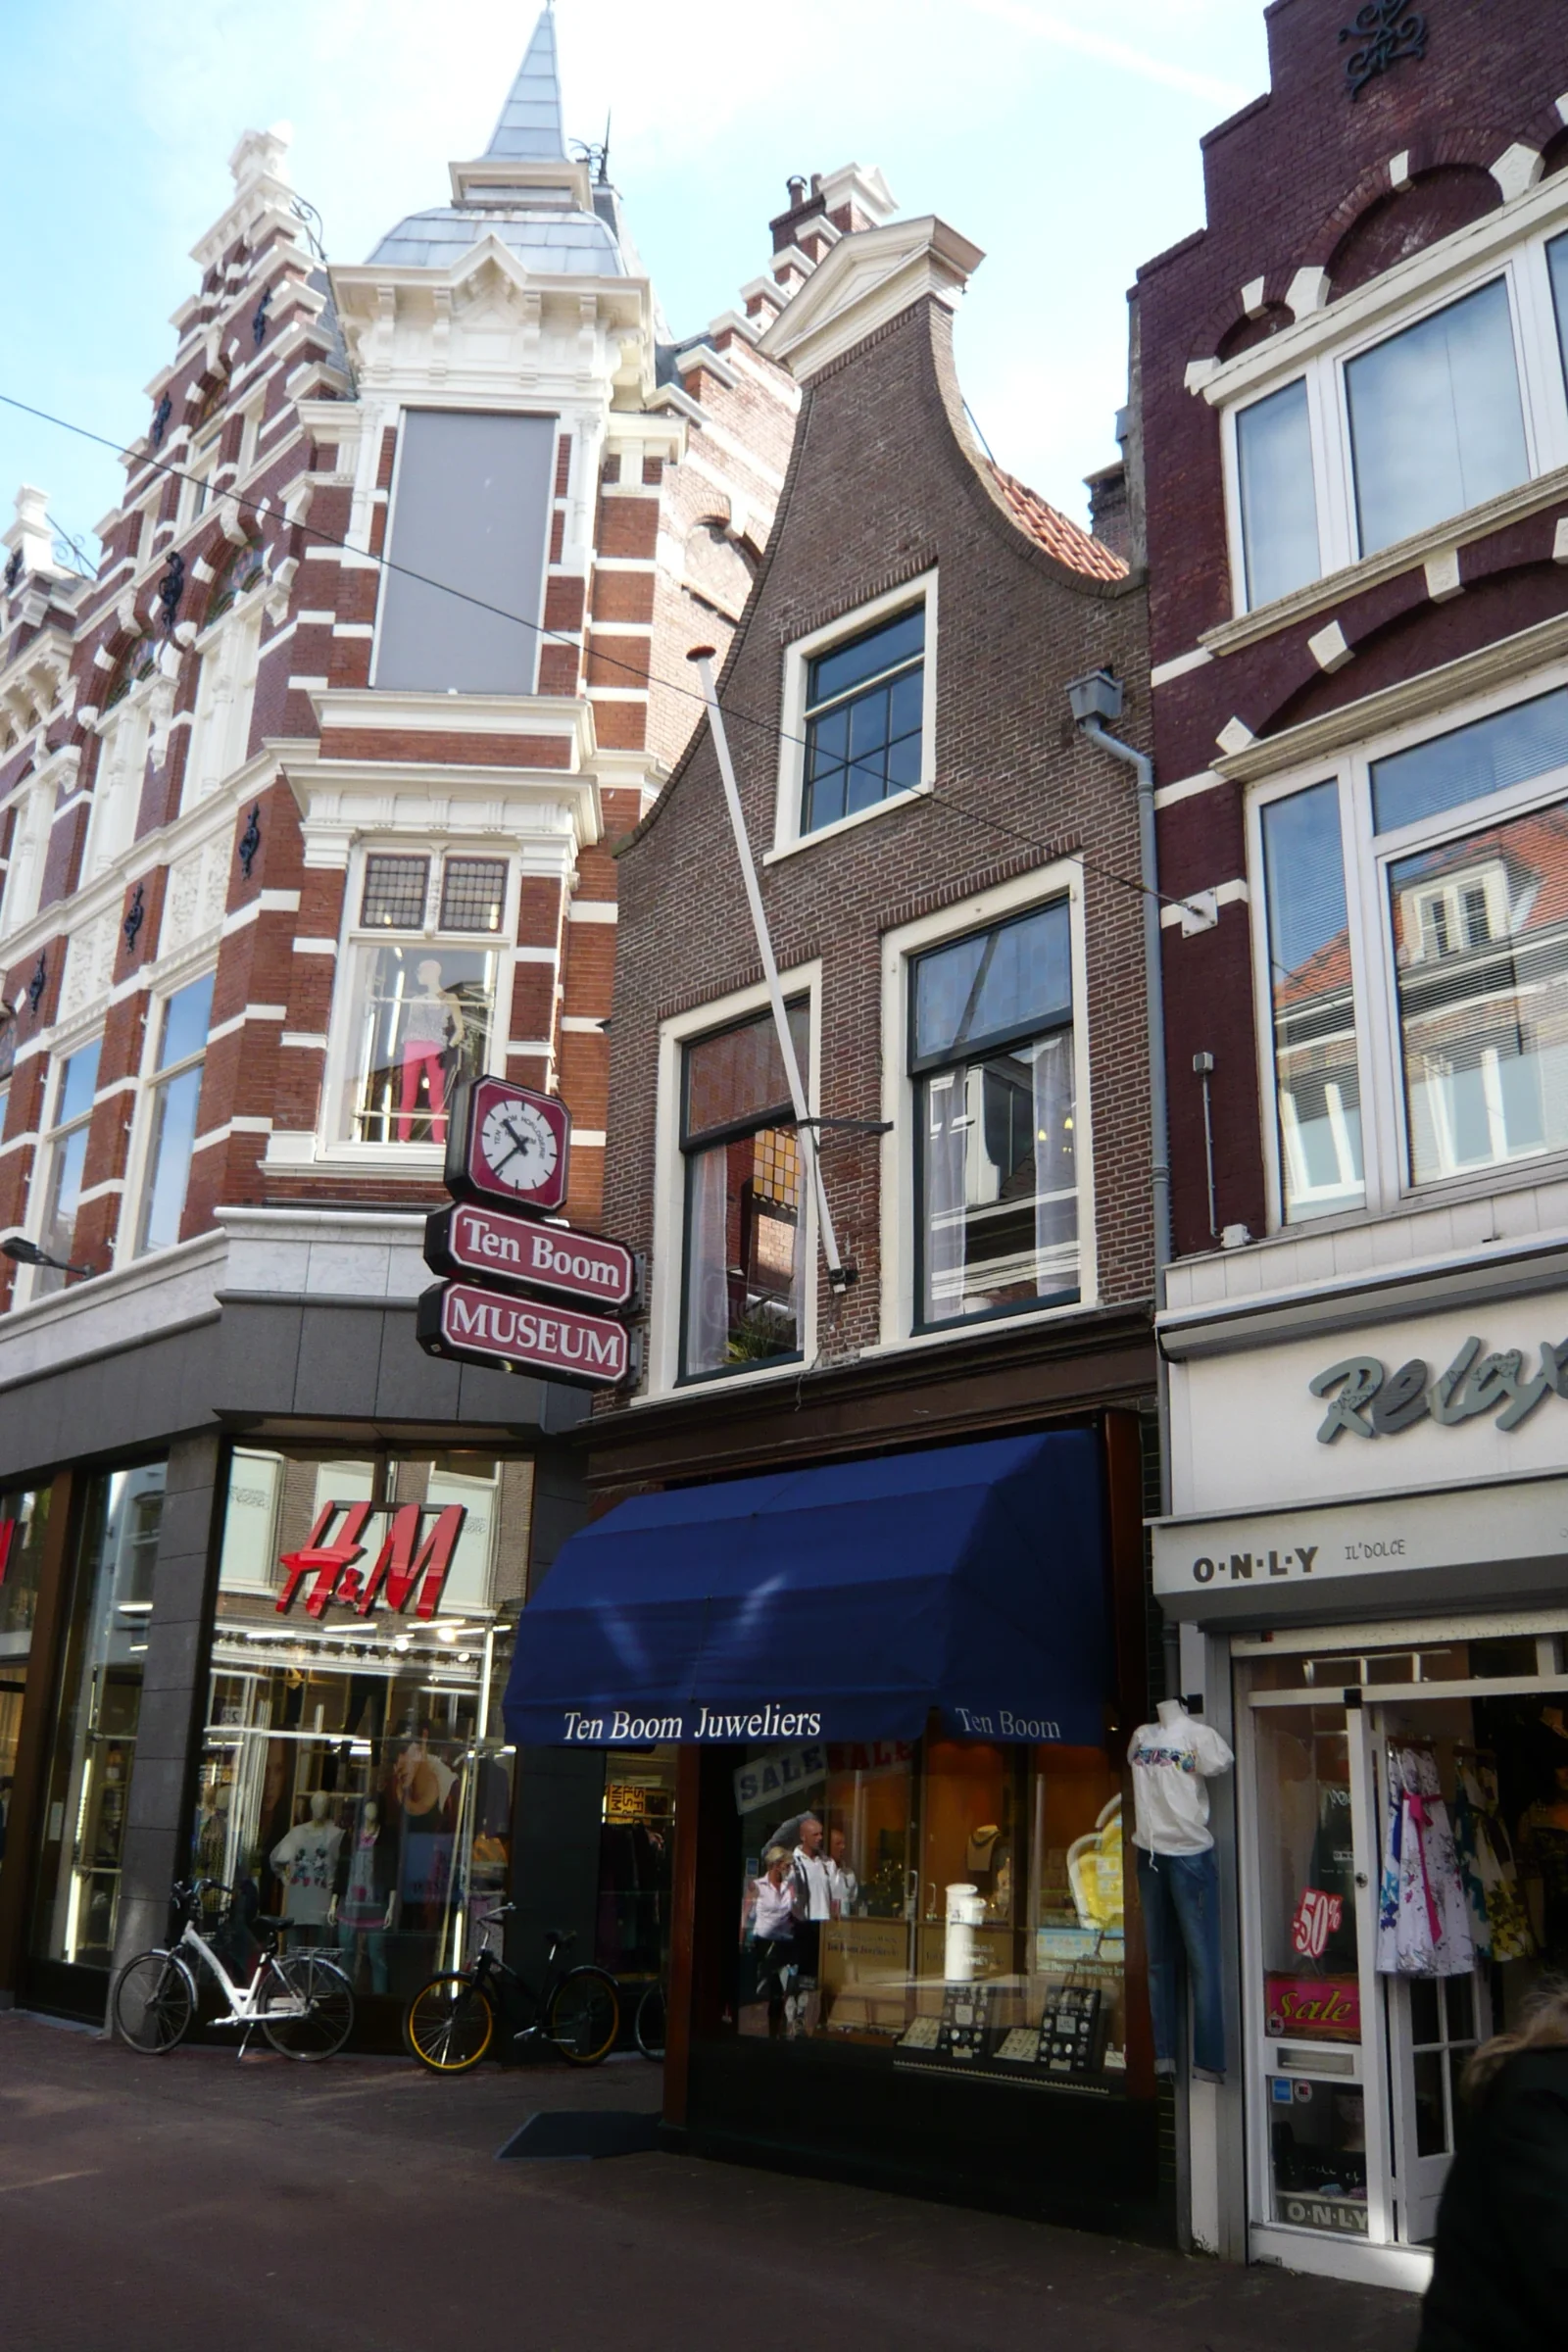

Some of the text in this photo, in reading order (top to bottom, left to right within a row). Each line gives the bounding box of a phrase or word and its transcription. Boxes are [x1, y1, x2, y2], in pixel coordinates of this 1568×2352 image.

[499, 1114, 518, 1128] BOM
[463, 1217, 620, 1288] Ten Boom
[451, 1297, 619, 1367] MUSEUM
[275, 1500, 465, 1620] H&M
[564, 1703, 821, 1740] Ten Boom Juweliers
[955, 1707, 1062, 1740] Ten Boom
[740, 1744, 823, 1800] SALE
[1280, 1989, 1352, 2022] Sale
